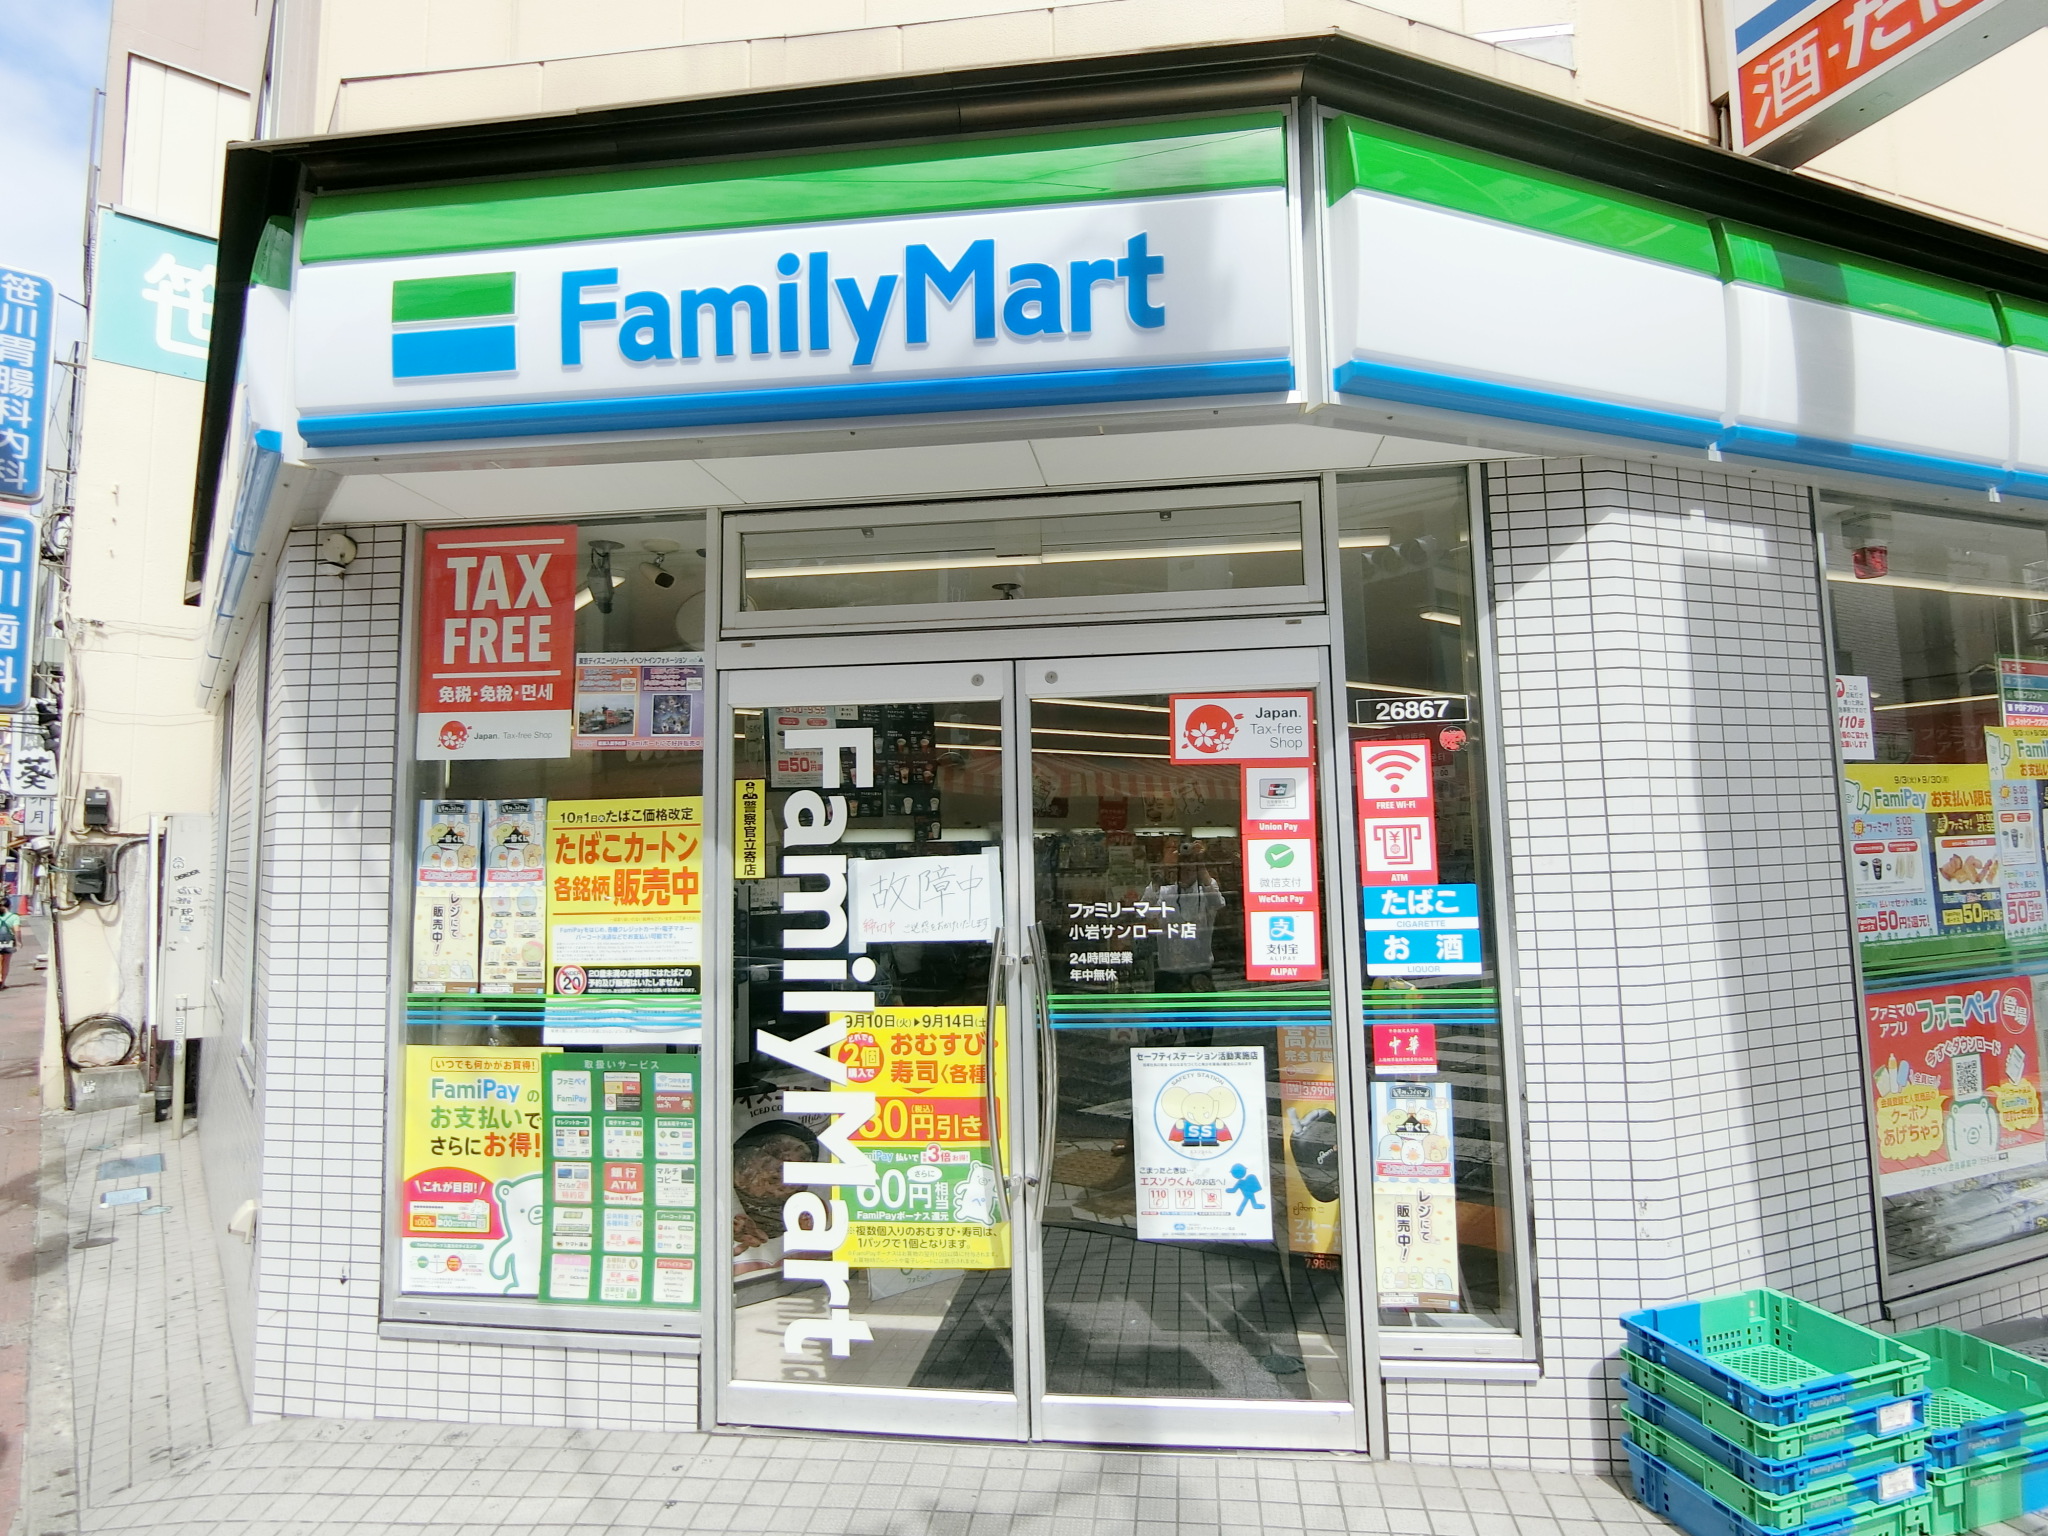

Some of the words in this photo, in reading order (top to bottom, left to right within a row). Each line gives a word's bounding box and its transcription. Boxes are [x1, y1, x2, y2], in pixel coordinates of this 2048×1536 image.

[562, 231, 1165, 366] FamilyMart
[447, 553, 552, 611] TAX
[443, 615, 552, 664] FREE
[1376, 700, 1449, 720] 26867
[1251, 723, 1303, 735] Tax-free
[503, 731, 532, 741] Tax-free
[534, 731, 552, 742] Shop
[1269, 737, 1303, 750] Shop
[1376, 801, 1395, 809] FREE
[1874, 788, 1927, 809] FamiPay
[1259, 823, 1282, 831] Union
[1284, 823, 1298, 832] Pay
[743, 800, 757, 876] 警察官立寄店
[555, 831, 698, 864] たばこカートン
[1259, 877, 1301, 888] 微信支付
[1391, 874, 1408, 882] ATM
[870, 865, 983, 921] 故障中
[1258, 895, 1287, 904] WeChat
[1289, 895, 1304, 905] Pay
[1381, 889, 1459, 916] たばこ
[450, 893, 461, 938] レジにて
[1068, 902, 1175, 919] ファミリーマート
[1396, 919, 1446, 928] CIGARETTE
[1069, 923, 1197, 941] 小岩サンロード店
[1266, 943, 1299, 955] 支付宝
[1069, 952, 1134, 965] 24時間営業
[1270, 967, 1298, 976] ALIPAY
[1407, 962, 1440, 973] LIQUOR
[1070, 969, 1118, 982] 年中無休
[563, 977, 581, 990] 20
[1870, 1002, 1915, 1021] ファミマの
[1916, 990, 2000, 1033] ファミペイ
[2003, 995, 2028, 1026] 登場
[1879, 1021, 1908, 1038] アプリ
[756, 727, 875, 1358] FamilyMart
[844, 1043, 880, 1067] 2個
[1925, 1036, 2001, 1067] 今すぐダウンロード
[584, 1060, 659, 1070] 取扱いサービス
[1171, 1073, 1195, 1086] SAFETY
[1197, 1073, 1225, 1086] STATION
[431, 1077, 520, 1102] FamiPay
[527, 1089, 539, 1103] の
[557, 1095, 587, 1103] FamiPay
[430, 1105, 542, 1130] お支払いで
[750, 1104, 770, 1118] ICED
[1891, 1105, 1930, 1125] クーポン
[1188, 1125, 1212, 1137] SS
[1884, 1119, 1941, 1147] あげちゃう
[430, 1132, 541, 1158] さらにお得!
[896, 1153, 919, 1162] 払いで
[611, 1167, 636, 1178] 銀行
[656, 1167, 679, 1175] マルチ
[914, 1170, 935, 1178] さらに
[423, 1181, 477, 1194] これが目印!
[611, 1181, 637, 1190] ATM
[1150, 1190, 1167, 1198] 110
[1176, 1190, 1193, 1198] 119
[1418, 1190, 1431, 1242] レジにて
